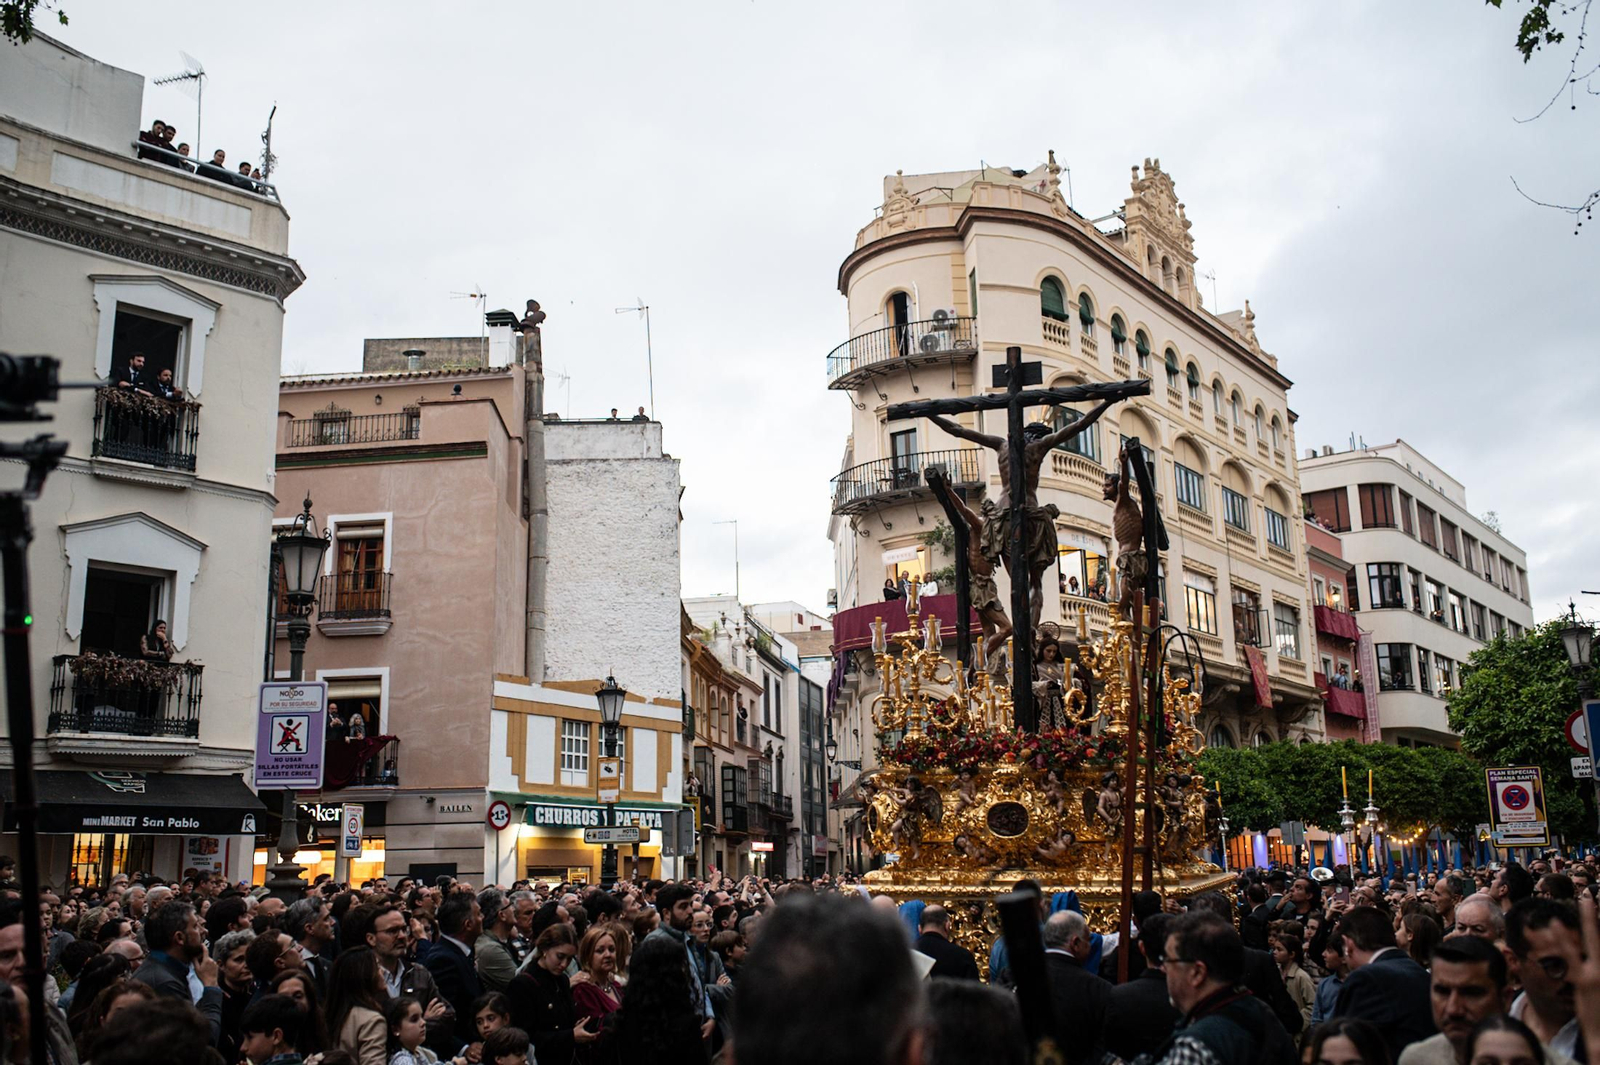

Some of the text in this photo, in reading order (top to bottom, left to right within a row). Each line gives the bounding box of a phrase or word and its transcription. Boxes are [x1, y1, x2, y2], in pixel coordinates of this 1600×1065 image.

[142, 817, 164, 827] San
[168, 817, 200, 828] Pablo
[535, 806, 599, 826] CHURROS
